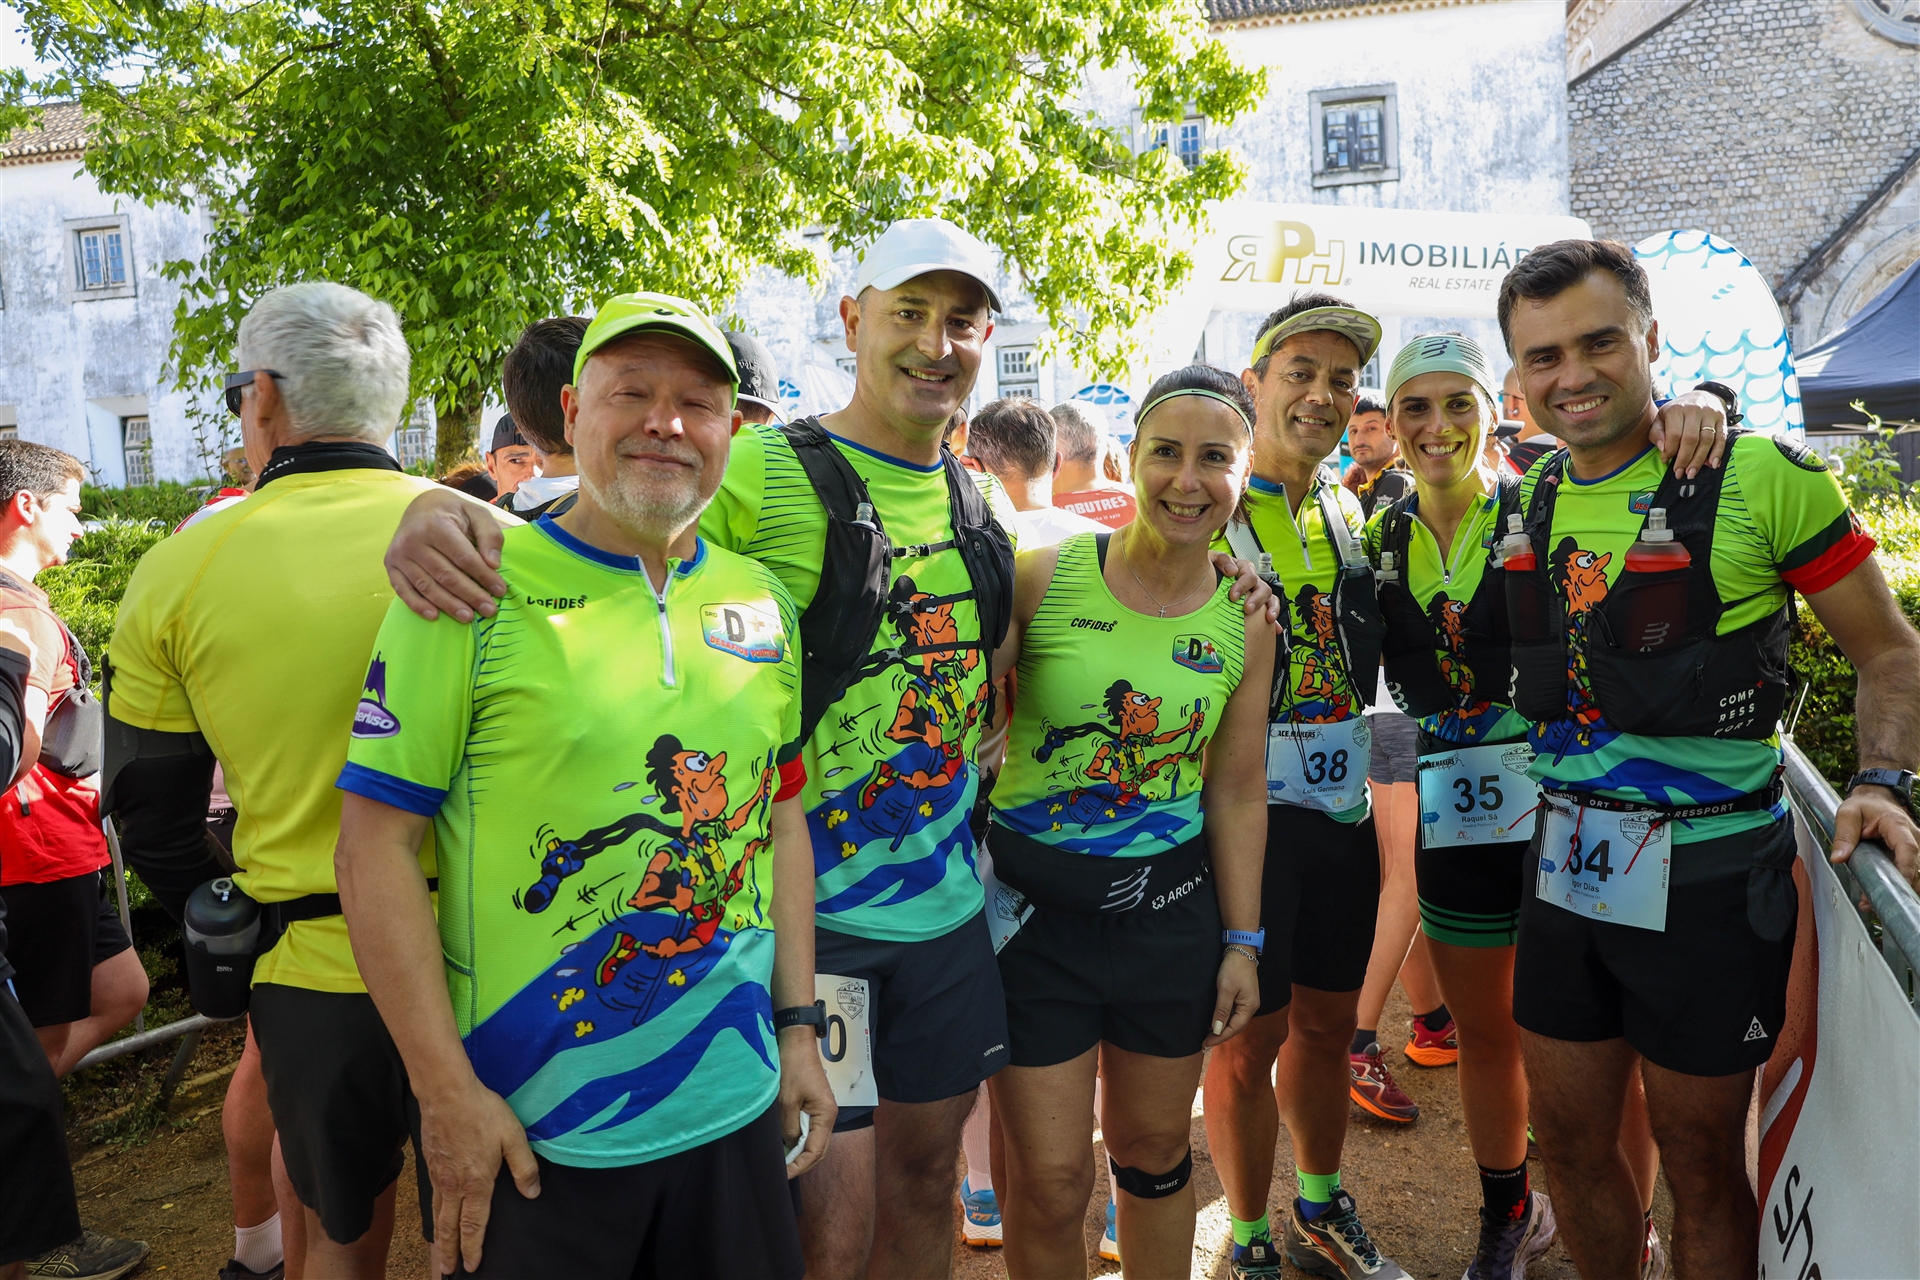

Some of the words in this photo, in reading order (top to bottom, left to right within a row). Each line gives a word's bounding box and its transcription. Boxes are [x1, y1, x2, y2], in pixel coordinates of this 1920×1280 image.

[1408, 276, 1441, 290] REAL
[1445, 278, 1494, 291] ESTATE
[1070, 617, 1115, 633] COFIDES
[709, 636, 750, 657] DESAFIOS
[1719, 688, 1755, 708] COMP
[1718, 702, 1755, 723] RESS
[1306, 748, 1348, 785] 38
[1317, 785, 1345, 793] Germano
[1453, 774, 1504, 814] 35
[1461, 814, 1486, 823] Raquel
[1569, 833, 1614, 882] 34
[1572, 878, 1582, 889] Igor
[1583, 882, 1600, 893] Dias
